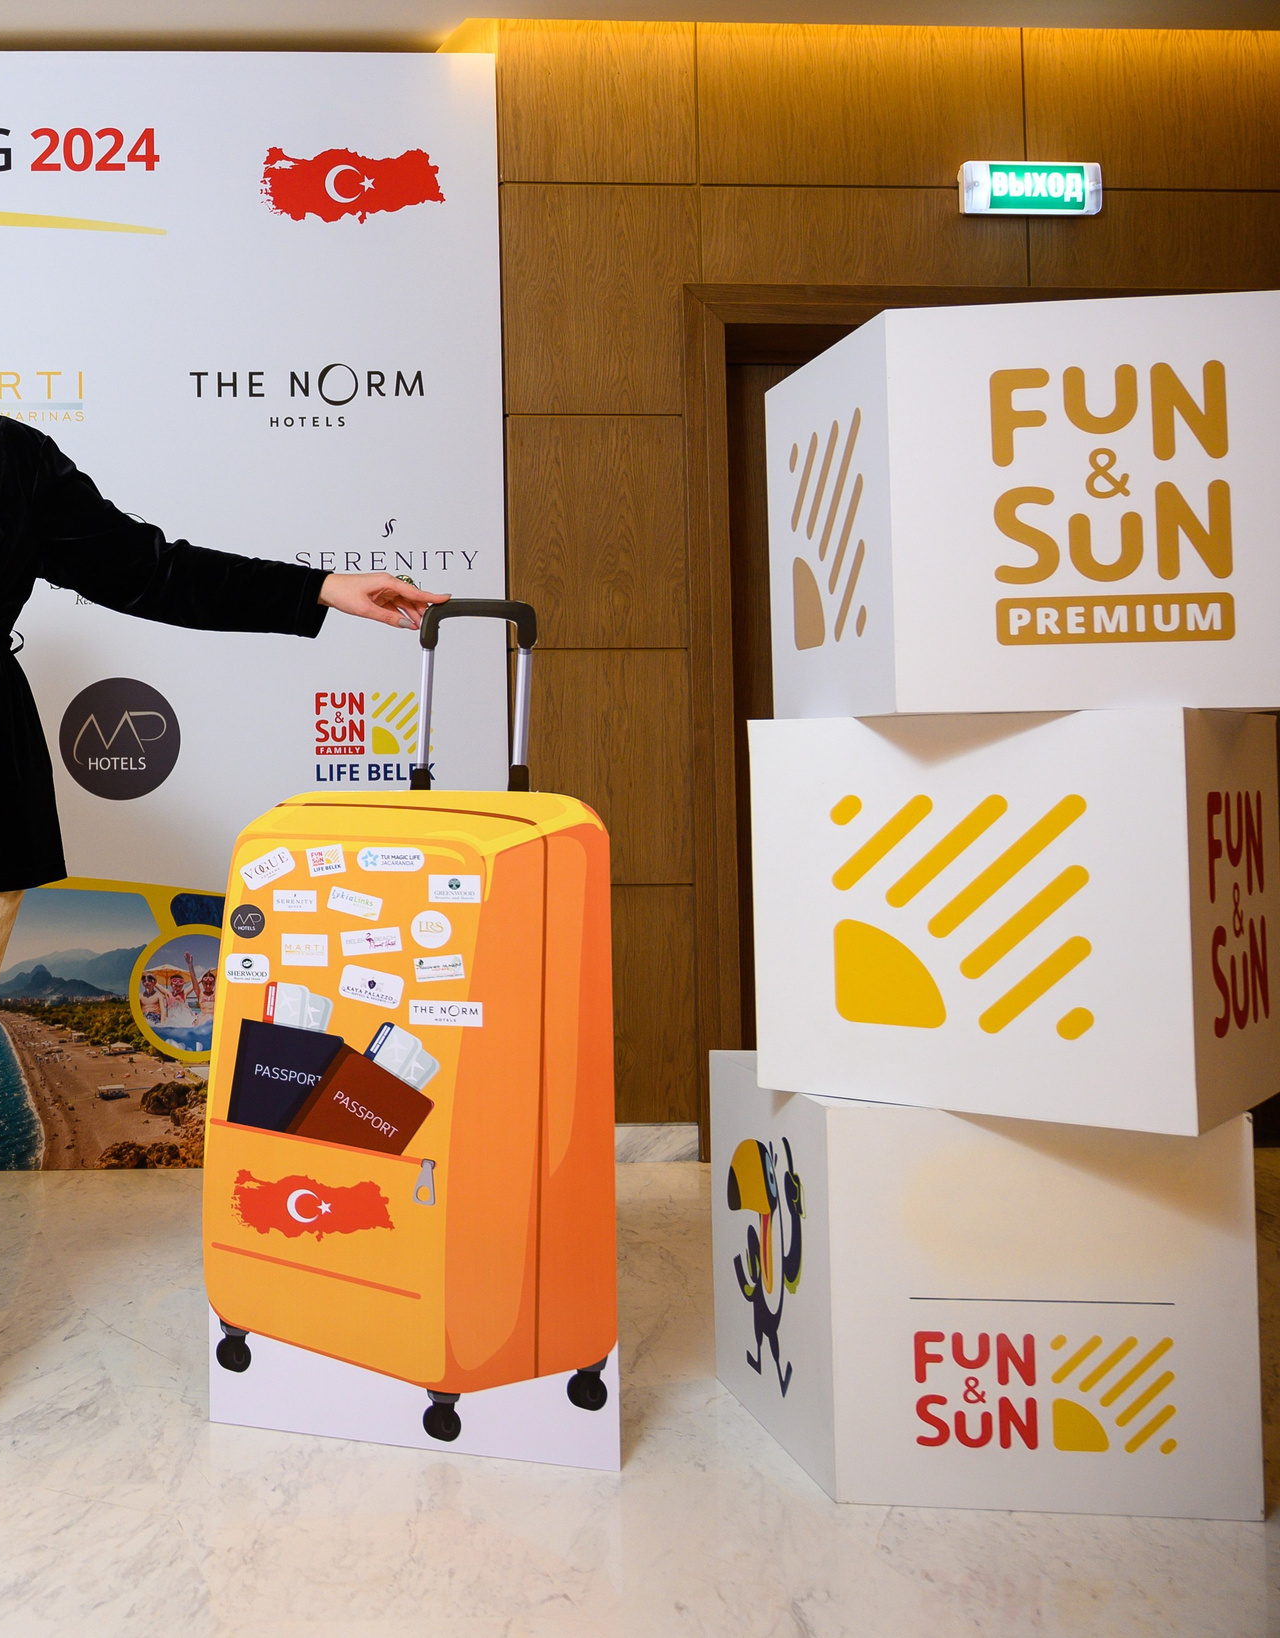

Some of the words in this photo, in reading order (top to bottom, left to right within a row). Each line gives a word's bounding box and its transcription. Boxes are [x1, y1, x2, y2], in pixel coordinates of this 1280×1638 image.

[29, 126, 160, 173] 2024
[992, 172, 1083, 202] ВЫХОД
[189, 372, 265, 398] THE
[290, 363, 425, 406] NORM
[270, 416, 345, 428] HOTELS
[989, 359, 1229, 467] FUN
[1085, 447, 1130, 499] &
[993, 479, 1234, 585] SUN
[295, 551, 479, 571] SERENITY
[1009, 603, 1222, 635] PREMIUM
[315, 692, 364, 715] FUN
[335, 711, 344, 723] &
[315, 719, 364, 742] SUN
[88, 757, 146, 770] HOTELS
[316, 764, 360, 781] LIFE
[1207, 790, 1264, 904] FUN
[1233, 882, 1244, 938] &
[1212, 915, 1269, 1039] SUN
[347, 986, 363, 994] KAYA
[365, 990, 393, 1001] PALAZZO
[441, 1005, 478, 1016] NORM
[333, 1090, 398, 1138] PASSPORT
[914, 1330, 1036, 1386] FUN
[962, 1376, 986, 1404] &
[916, 1394, 1038, 1450] SUN
